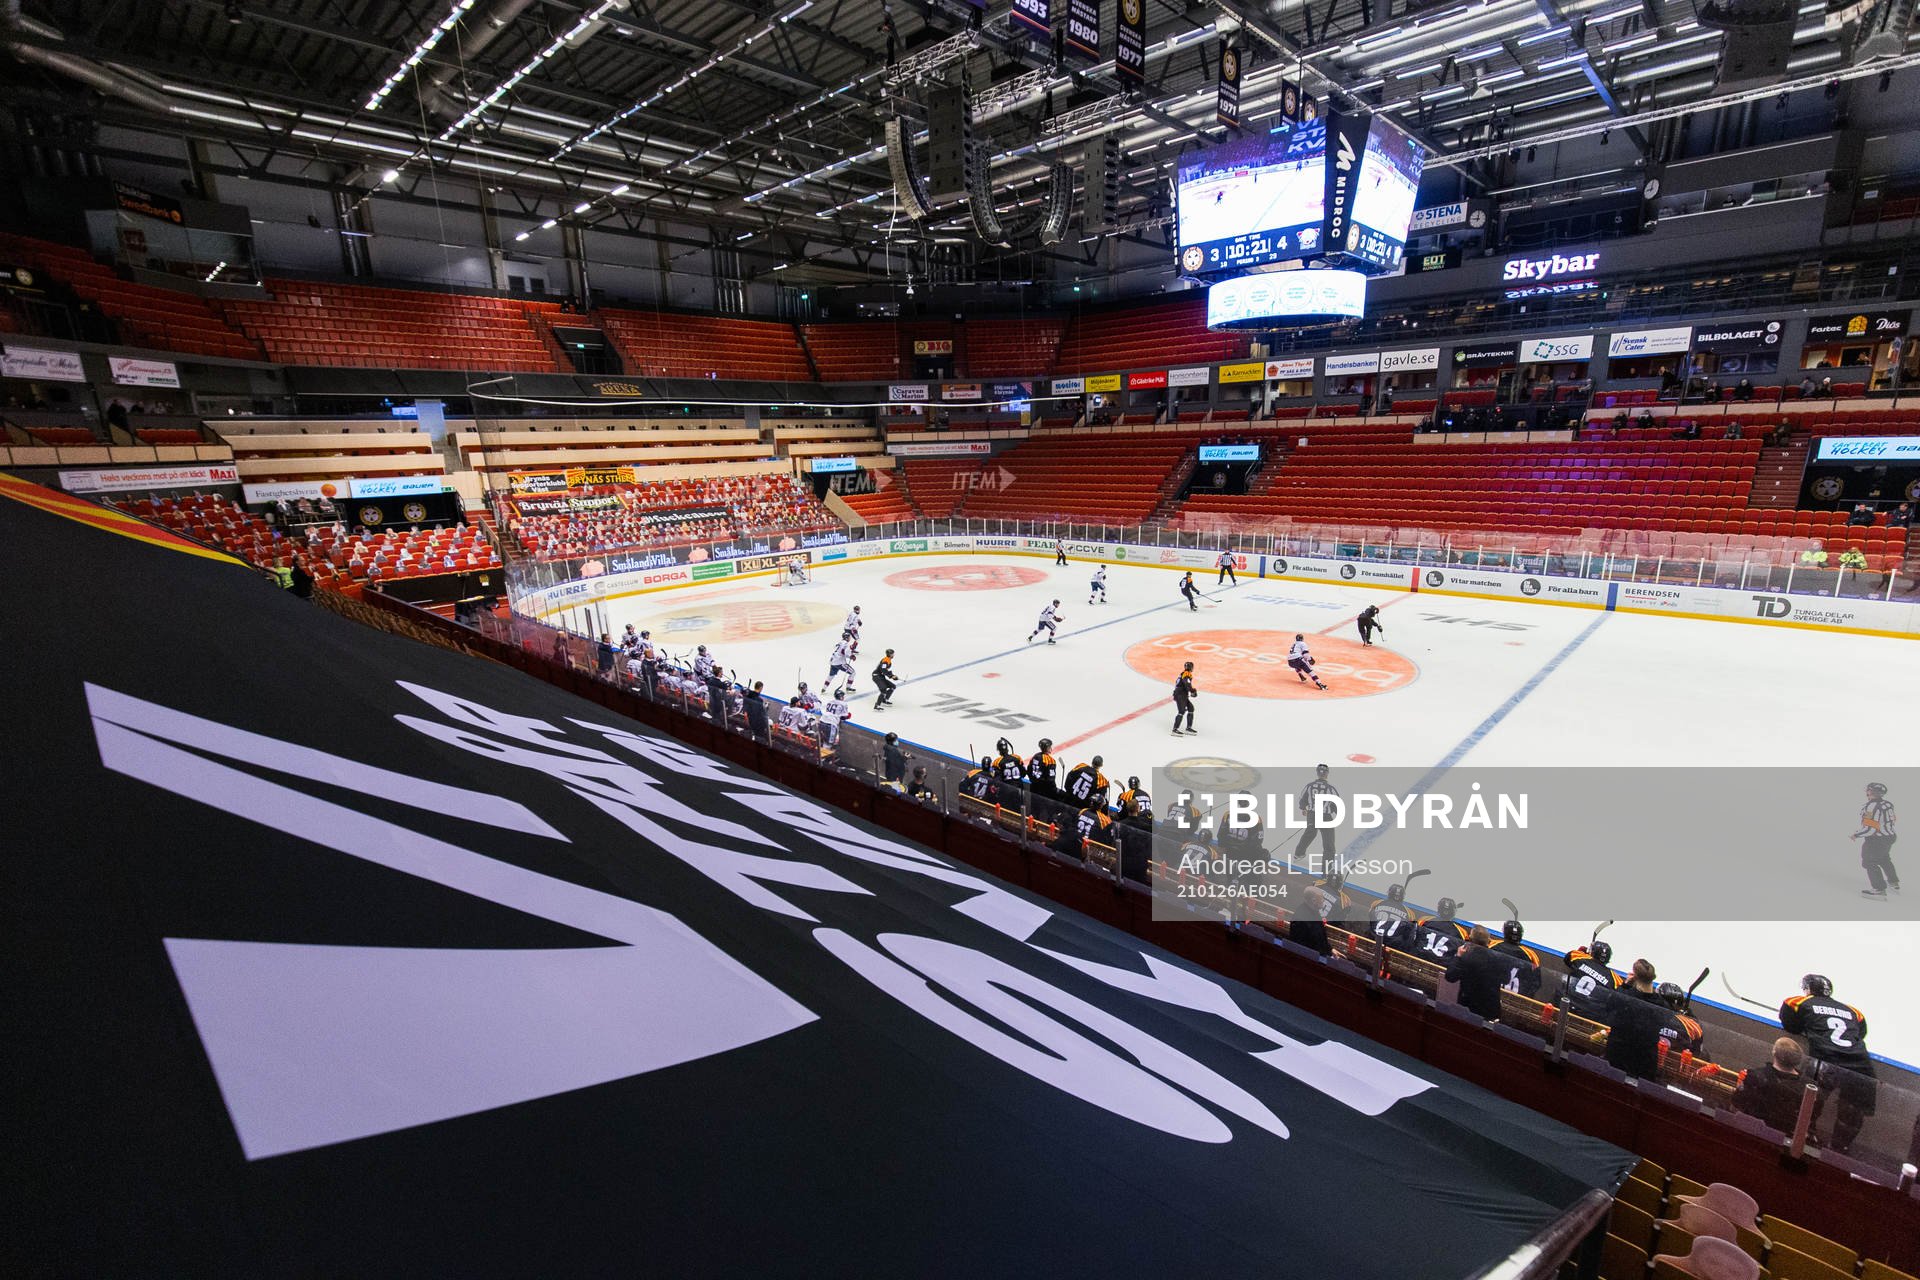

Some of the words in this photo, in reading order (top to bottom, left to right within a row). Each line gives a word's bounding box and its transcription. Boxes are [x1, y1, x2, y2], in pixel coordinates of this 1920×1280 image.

[1069, 19, 1099, 45] 1980
[1118, 44, 1143, 67] 1977
[1219, 99, 1237, 116] 1971
[1331, 176, 1347, 239] MIDROC
[1425, 203, 1462, 220] STENA
[1228, 240, 1269, 259] 10:21
[1276, 236, 1288, 250] 4
[1210, 248, 1220, 262] 3
[1503, 253, 1600, 281] Skybar
[1622, 335, 1648, 345] Svensk
[1697, 330, 1763, 342] BILBOLAGET
[1553, 344, 1580, 356] SSG
[1624, 343, 1646, 351] Cater
[1326, 359, 1378, 369] Handelsbanken
[896, 387, 924, 395] Caravan
[1830, 446, 1887, 456] HOCKEY
[569, 495, 619, 509] Support
[1027, 539, 1056, 549] PEAB
[643, 571, 688, 585] BORGA
[1469, 579, 1502, 588] matchen
[1576, 587, 1599, 596] barn
[1625, 588, 1681, 599] BERENDSEN
[1752, 595, 1792, 618] TD
[1792, 614, 1828, 623] SVERIGE
[1794, 609, 1823, 617] TUNGA
[1825, 611, 1854, 620] DELAR
[1153, 637, 1404, 687] besson
[920, 692, 1051, 730] SHL
[1072, 777, 1093, 800] 45
[1374, 911, 1401, 937] 27
[1424, 932, 1449, 957] 16
[1811, 1004, 1853, 1020] BERGLUND
[1826, 1016, 1853, 1047] 2
